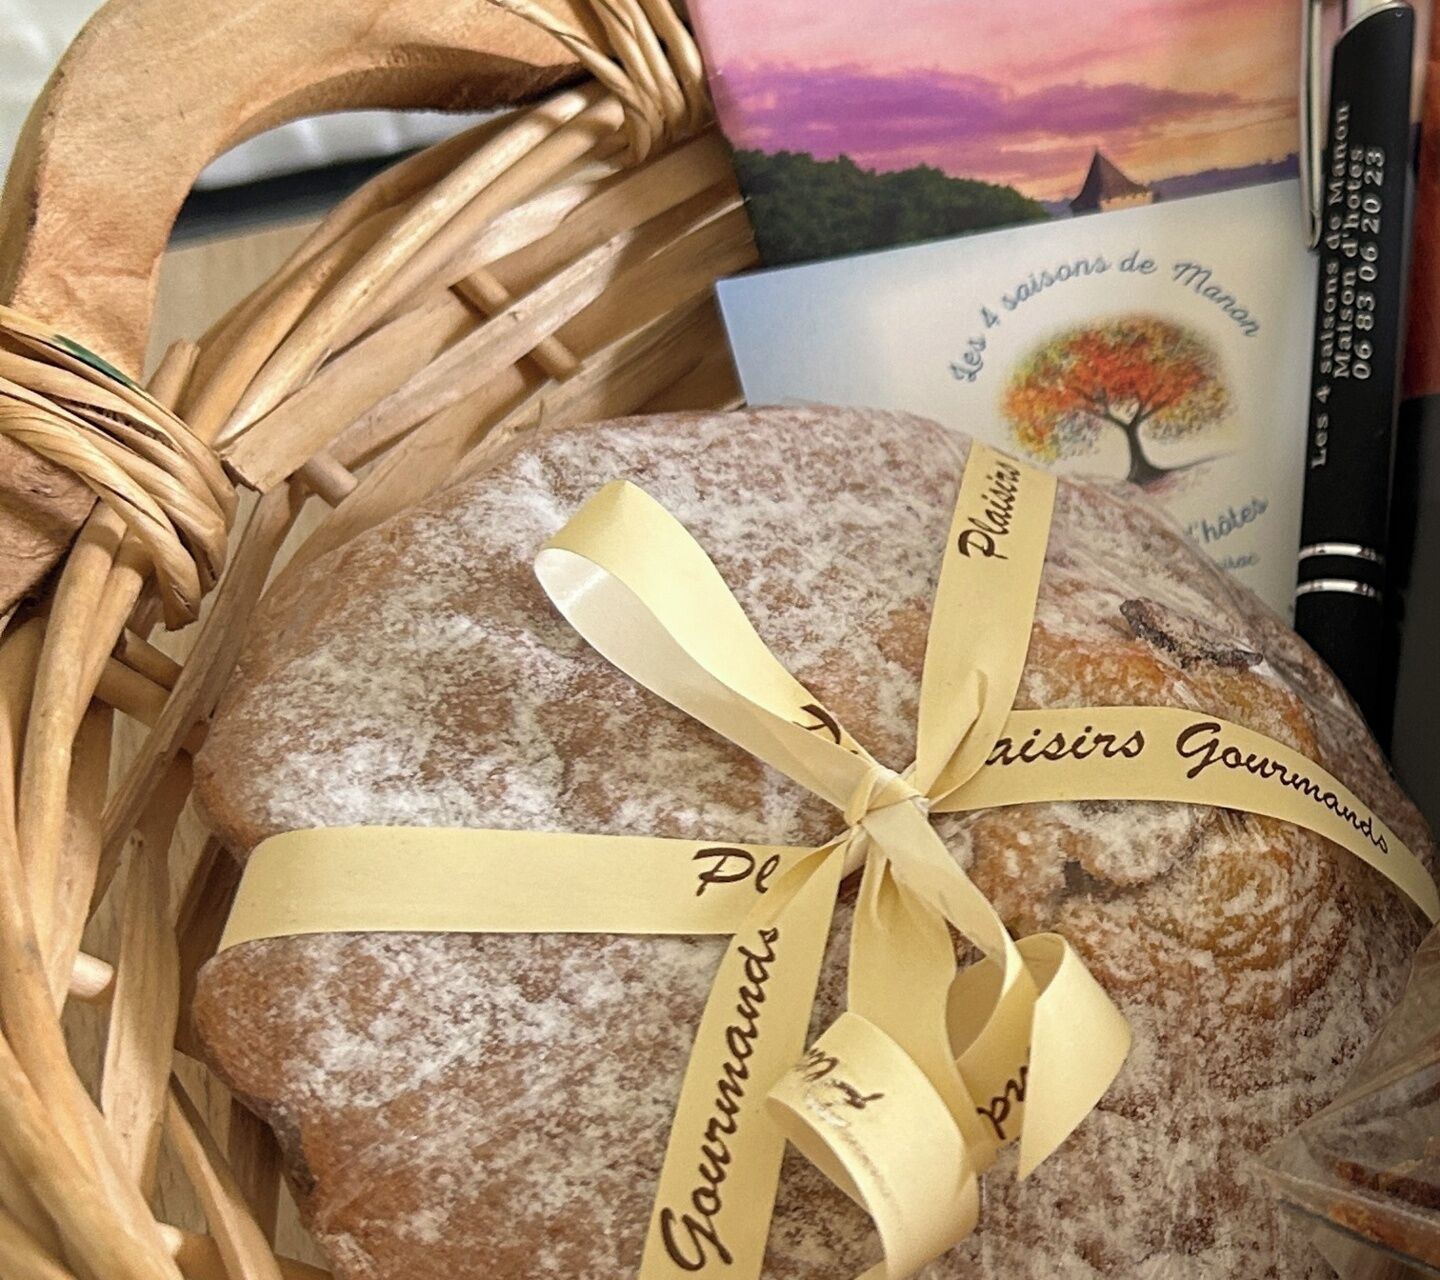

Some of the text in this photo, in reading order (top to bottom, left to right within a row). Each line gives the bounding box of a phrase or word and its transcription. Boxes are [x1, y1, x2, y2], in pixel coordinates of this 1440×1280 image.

[950, 249, 1262, 383] Les 4 saisons de Manon
[1311, 102, 1350, 470] Les 4 saisons de Manon
[1333, 267, 1357, 379] Maison
[1352, 146, 1386, 381] 06 83 06 20 23
[958, 461, 1021, 560] Plaisirs
[985, 721, 1390, 856] aisirs Gourmands
[660, 926, 780, 1273] Gourmands
